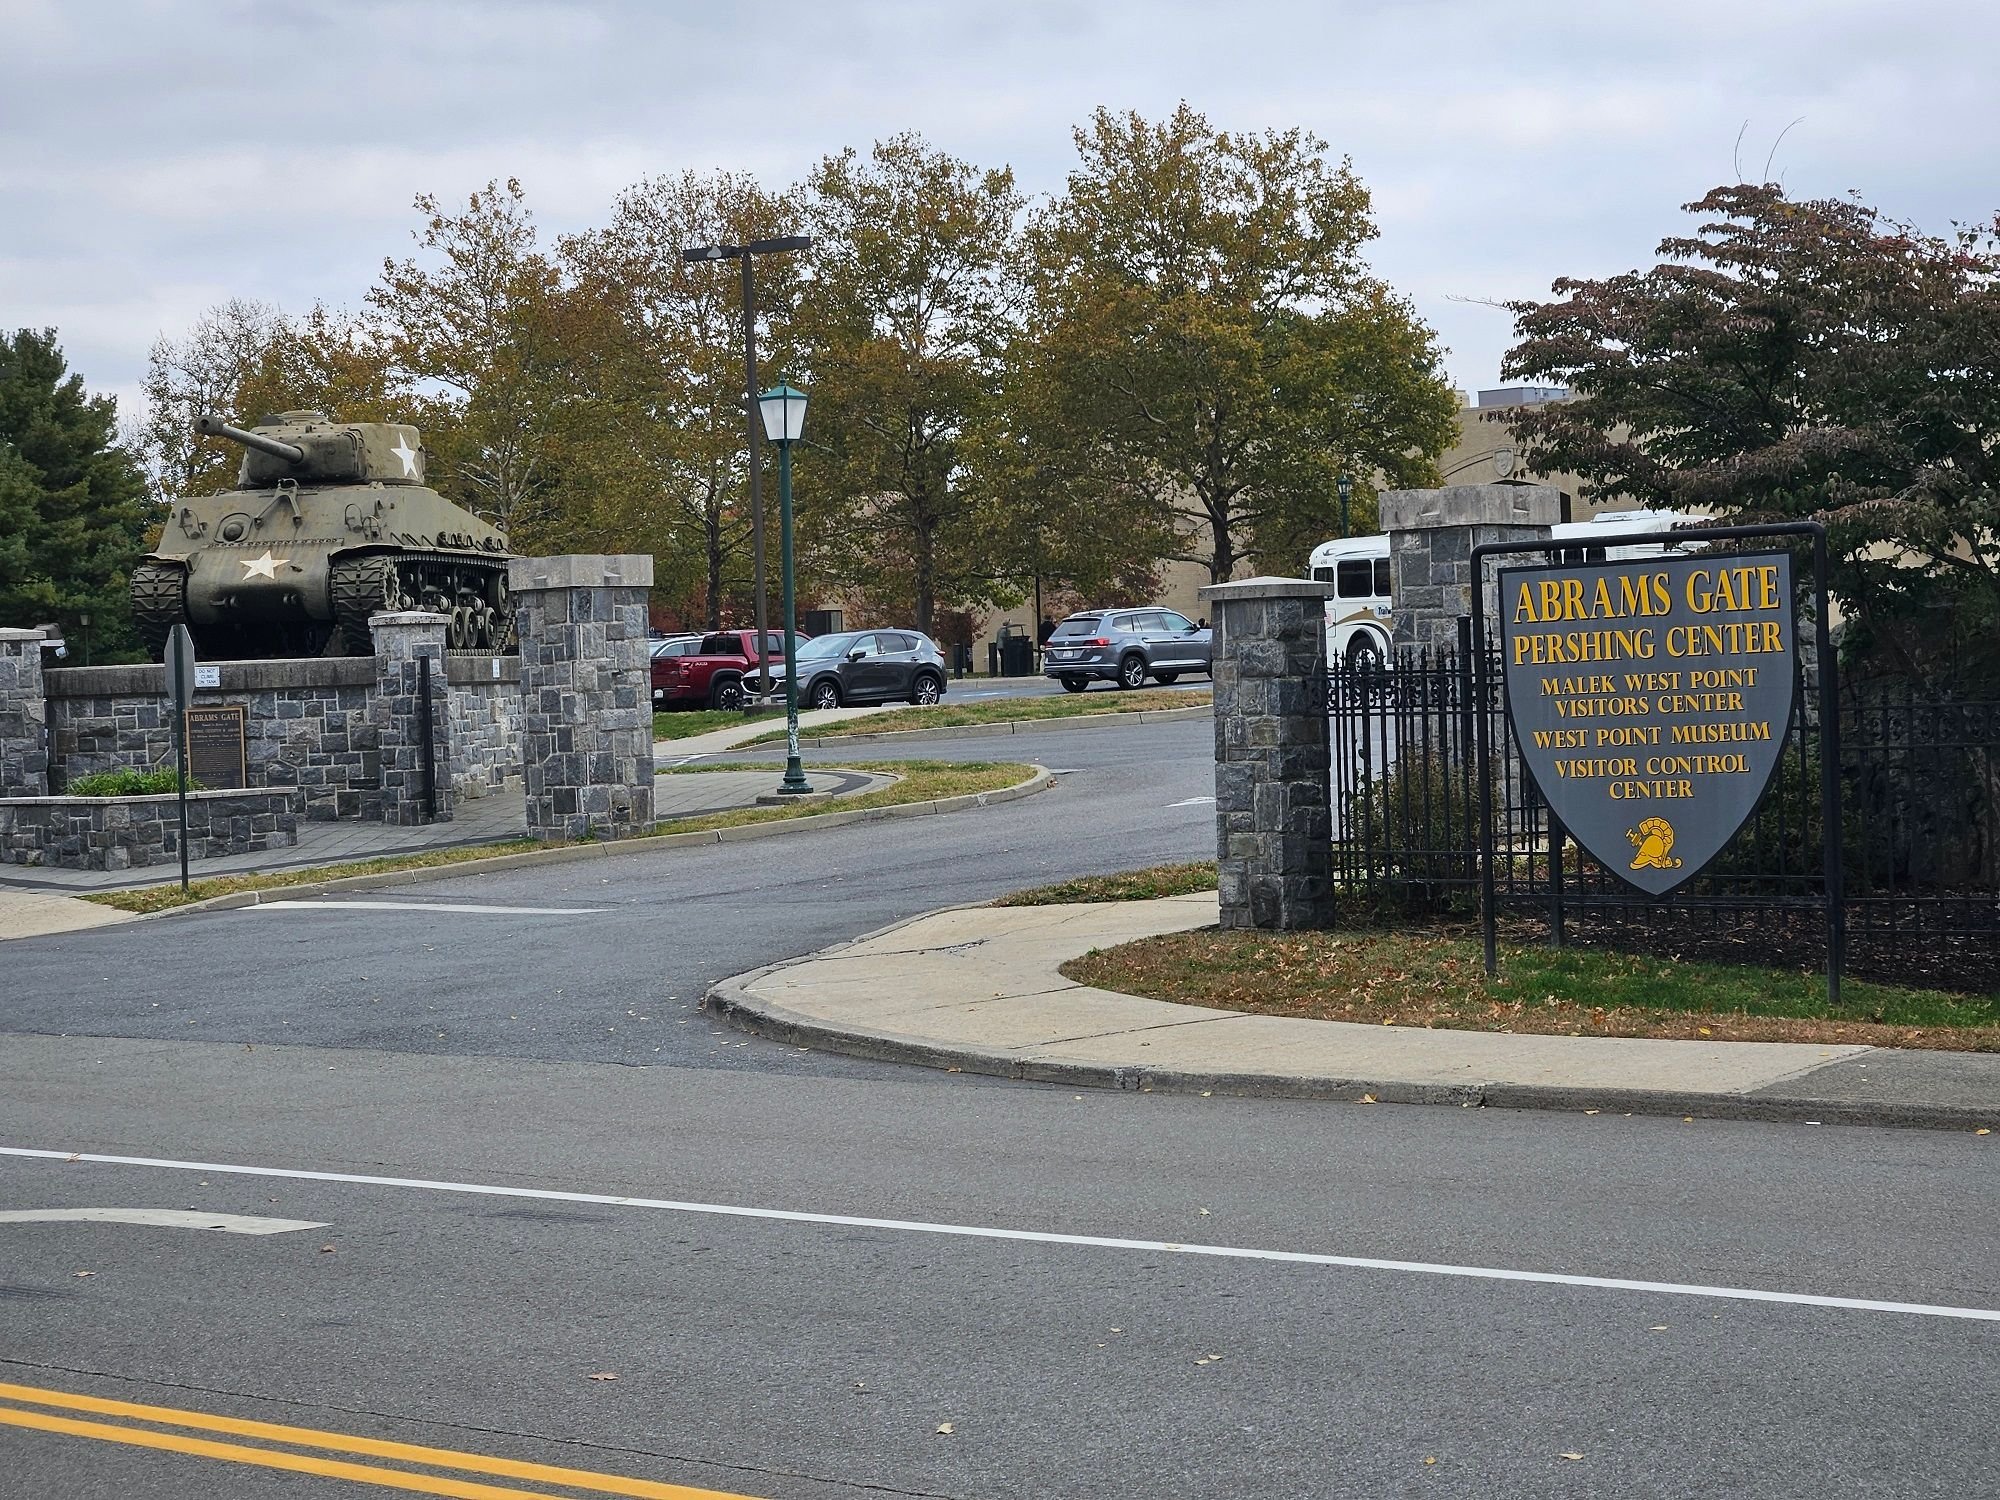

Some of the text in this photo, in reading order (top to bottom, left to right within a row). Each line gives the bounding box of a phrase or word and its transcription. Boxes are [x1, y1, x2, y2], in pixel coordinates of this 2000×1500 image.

[1513, 565, 1781, 623] ABRAMS GATE
[1513, 621, 1784, 665] PERSHING CENTER
[1540, 668, 1758, 696] MALEK WEST POINT
[190, 712, 240, 722] ABRAMS GATE
[1554, 692, 1744, 717] VISITORS CENTER
[1533, 721, 1771, 748] WEST POINT MUSEUM
[1554, 754, 1750, 779] VISITOR CONTROL
[1609, 779, 1694, 800] CENTER
